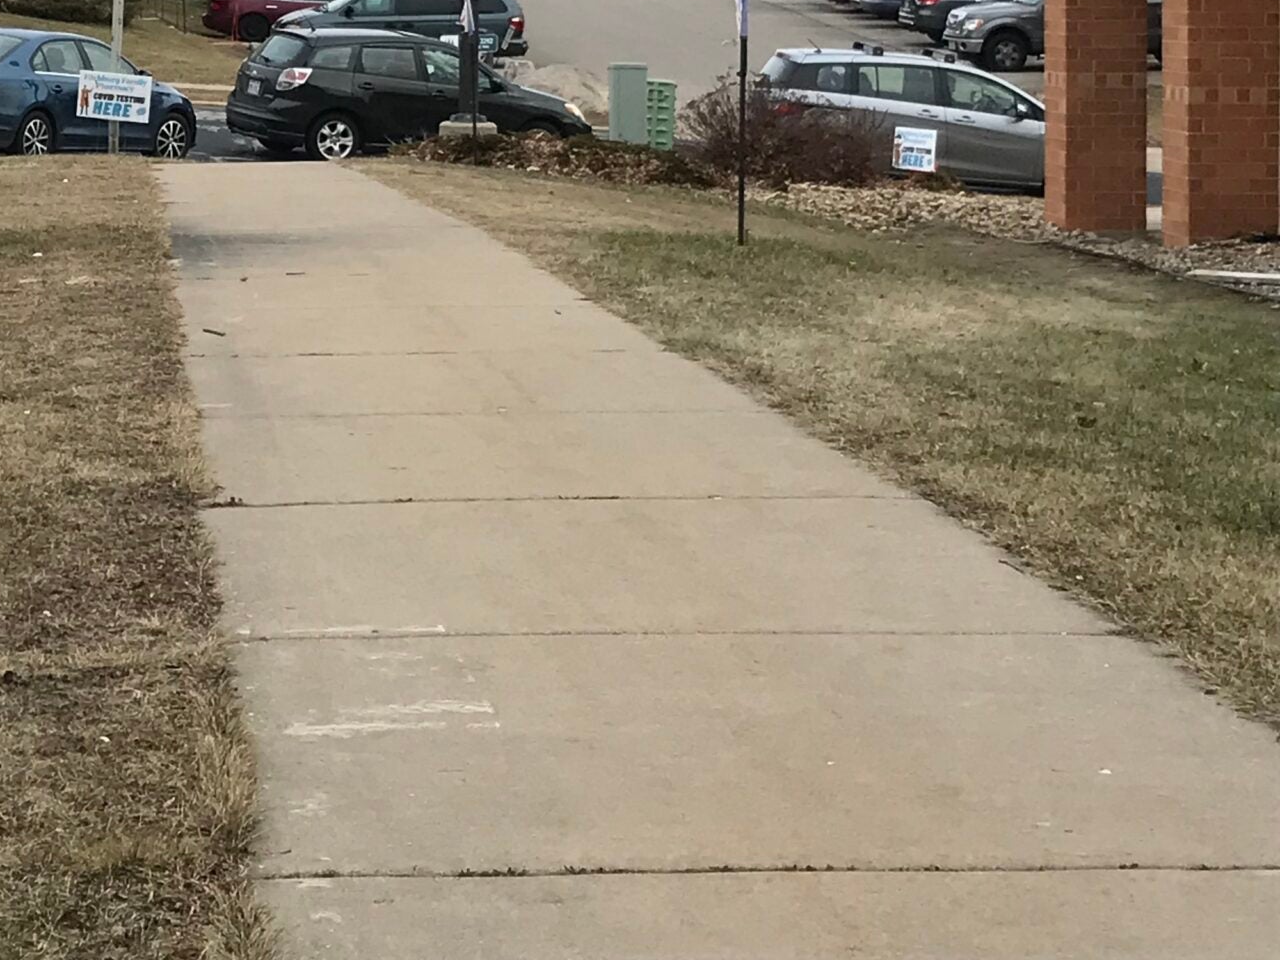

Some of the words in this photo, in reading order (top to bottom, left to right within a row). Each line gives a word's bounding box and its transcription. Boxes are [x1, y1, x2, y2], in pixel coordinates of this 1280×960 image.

[93, 92, 115, 101] COVID
[92, 101, 132, 118] HERE
[901, 154, 925, 167] HERE
